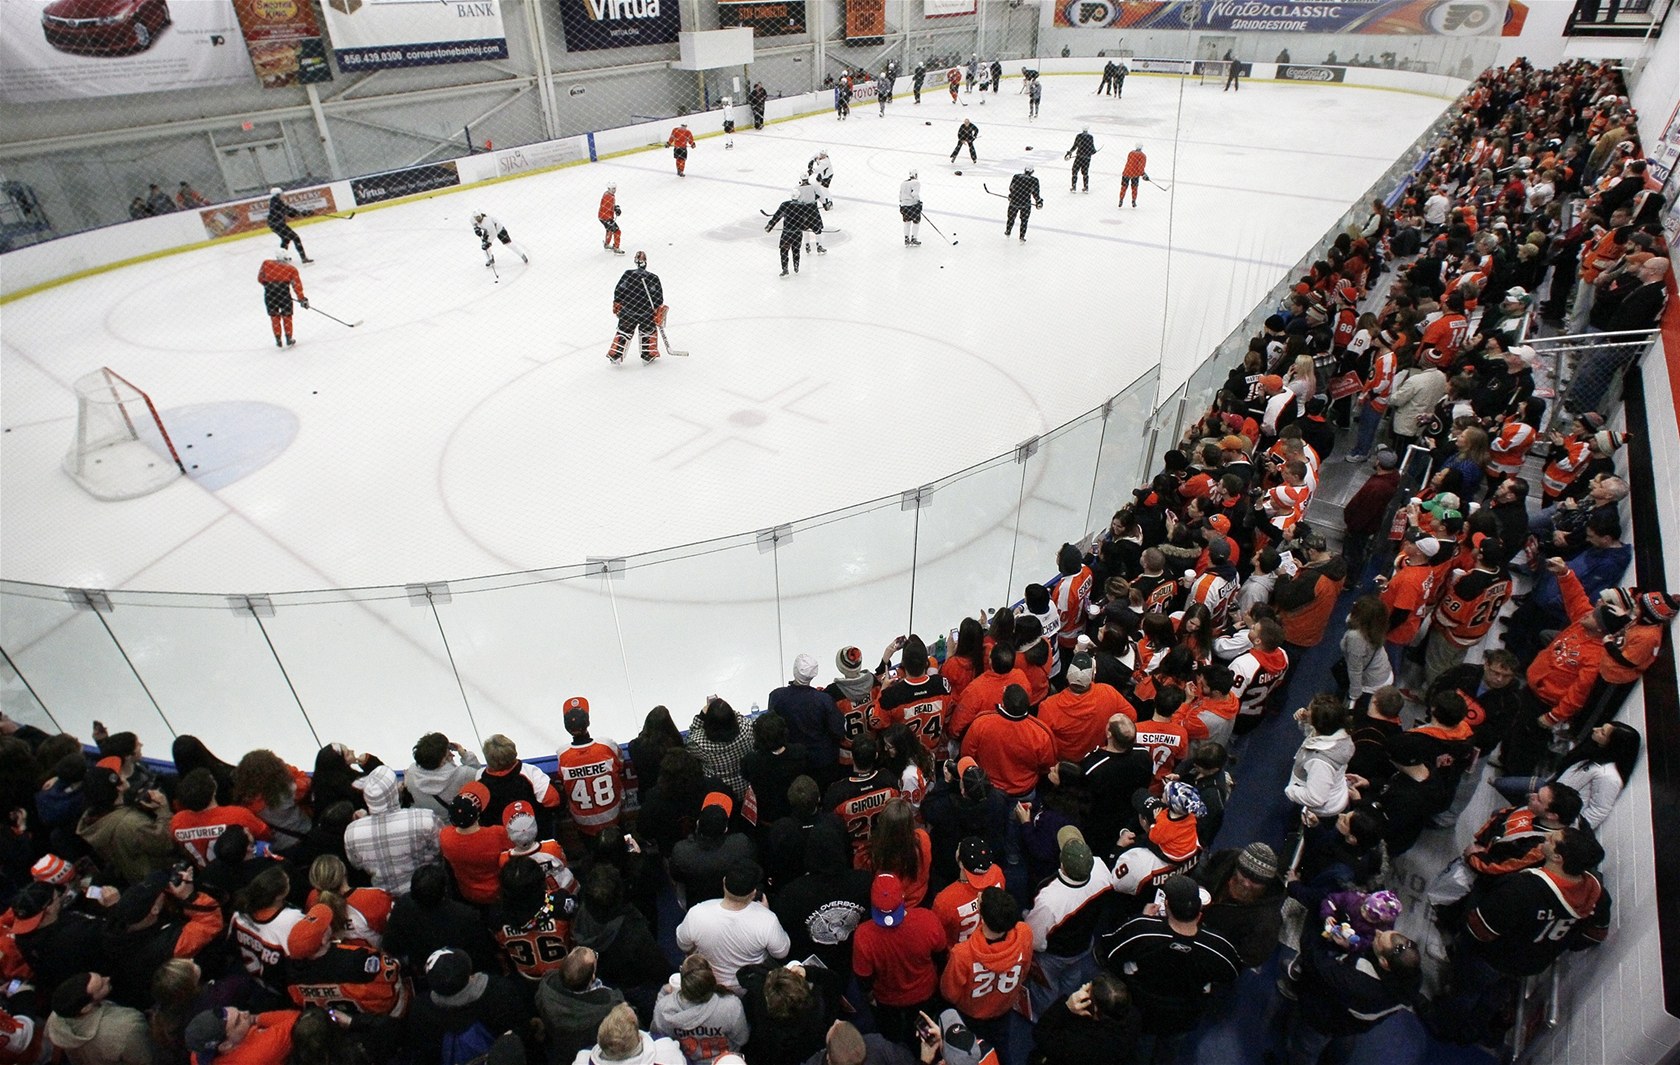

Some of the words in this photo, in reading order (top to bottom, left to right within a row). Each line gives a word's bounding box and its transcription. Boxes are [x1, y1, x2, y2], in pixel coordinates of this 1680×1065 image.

[457, 3, 495, 18] BANK
[1270, 5, 1342, 18] CLASSIC
[1230, 18, 1308, 30] BRIDGESTONE
[853, 86, 877, 99] TOYOT
[1340, 322, 1353, 334] 88
[1352, 337, 1364, 347] 19
[1142, 734, 1177, 745] SCHENN
[568, 762, 607, 779] BRIERE
[571, 774, 616, 810] 48
[851, 792, 887, 814] GIROUX
[505, 936, 568, 967] 36
[972, 963, 1022, 998] 28
[673, 1025, 723, 1038] GIROUX
